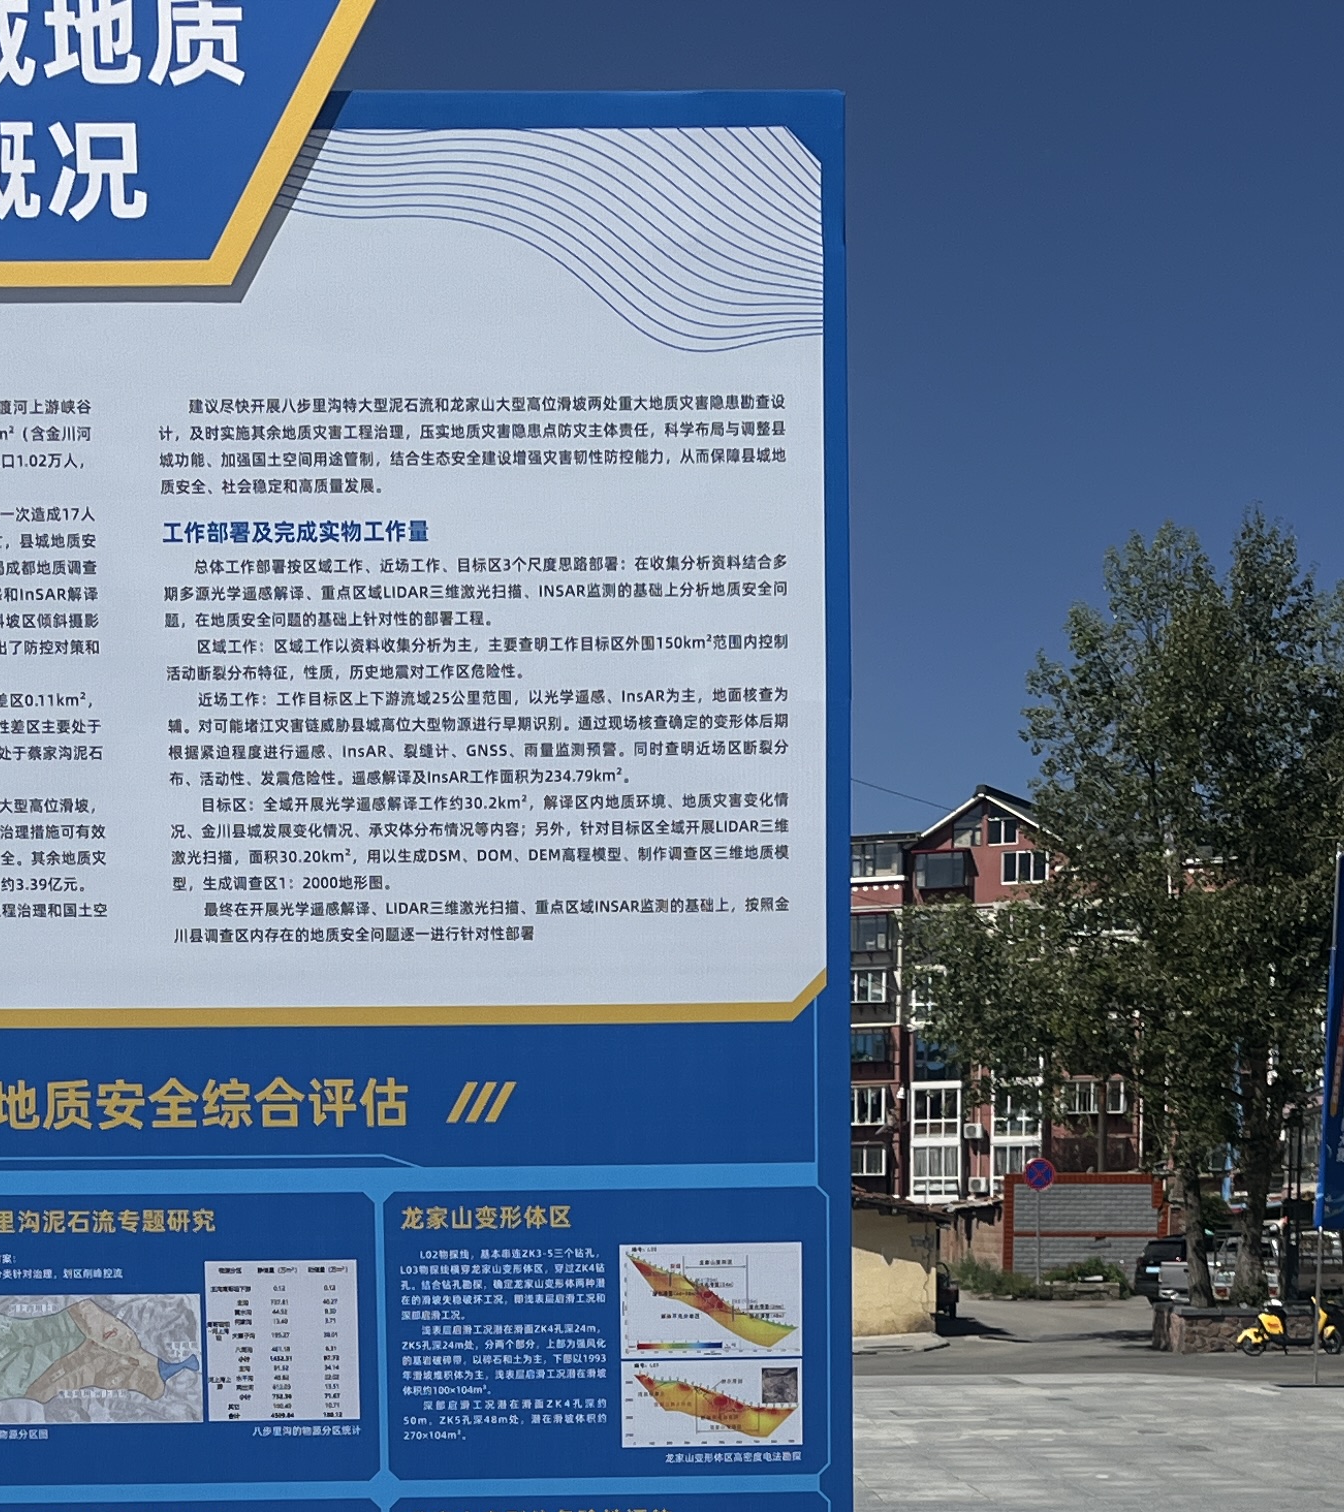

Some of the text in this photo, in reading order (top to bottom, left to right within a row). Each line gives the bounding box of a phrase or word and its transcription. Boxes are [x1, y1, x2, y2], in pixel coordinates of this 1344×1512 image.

[160, 477, 382, 496] 质安全、社会稳定和高质量发展。
[162, 519, 430, 545] 工作部署及完成实物工作量
[172, 874, 391, 892] 型，生成调查区1：2000地形图。
[400, 1204, 572, 1230] 龙家山变形体区
